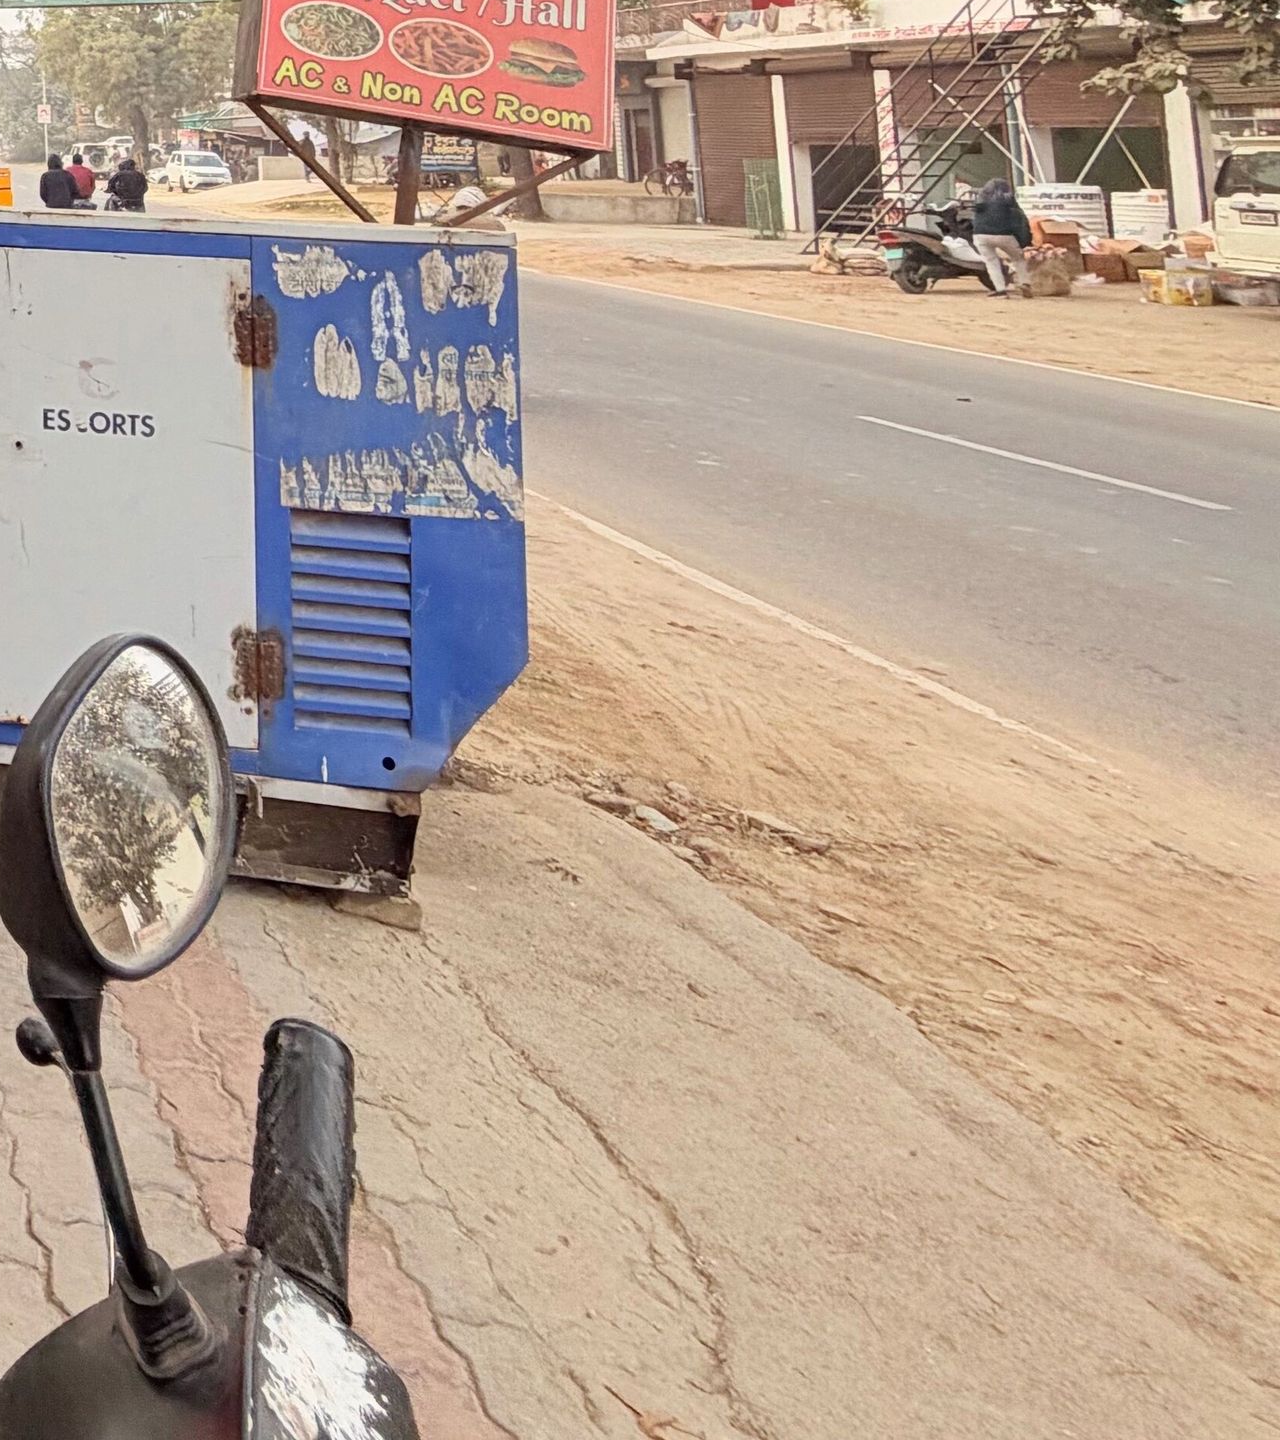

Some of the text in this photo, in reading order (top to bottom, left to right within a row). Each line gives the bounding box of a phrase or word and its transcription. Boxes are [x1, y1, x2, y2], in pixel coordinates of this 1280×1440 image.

[273, 57, 592, 133] AC & Non AC Room
